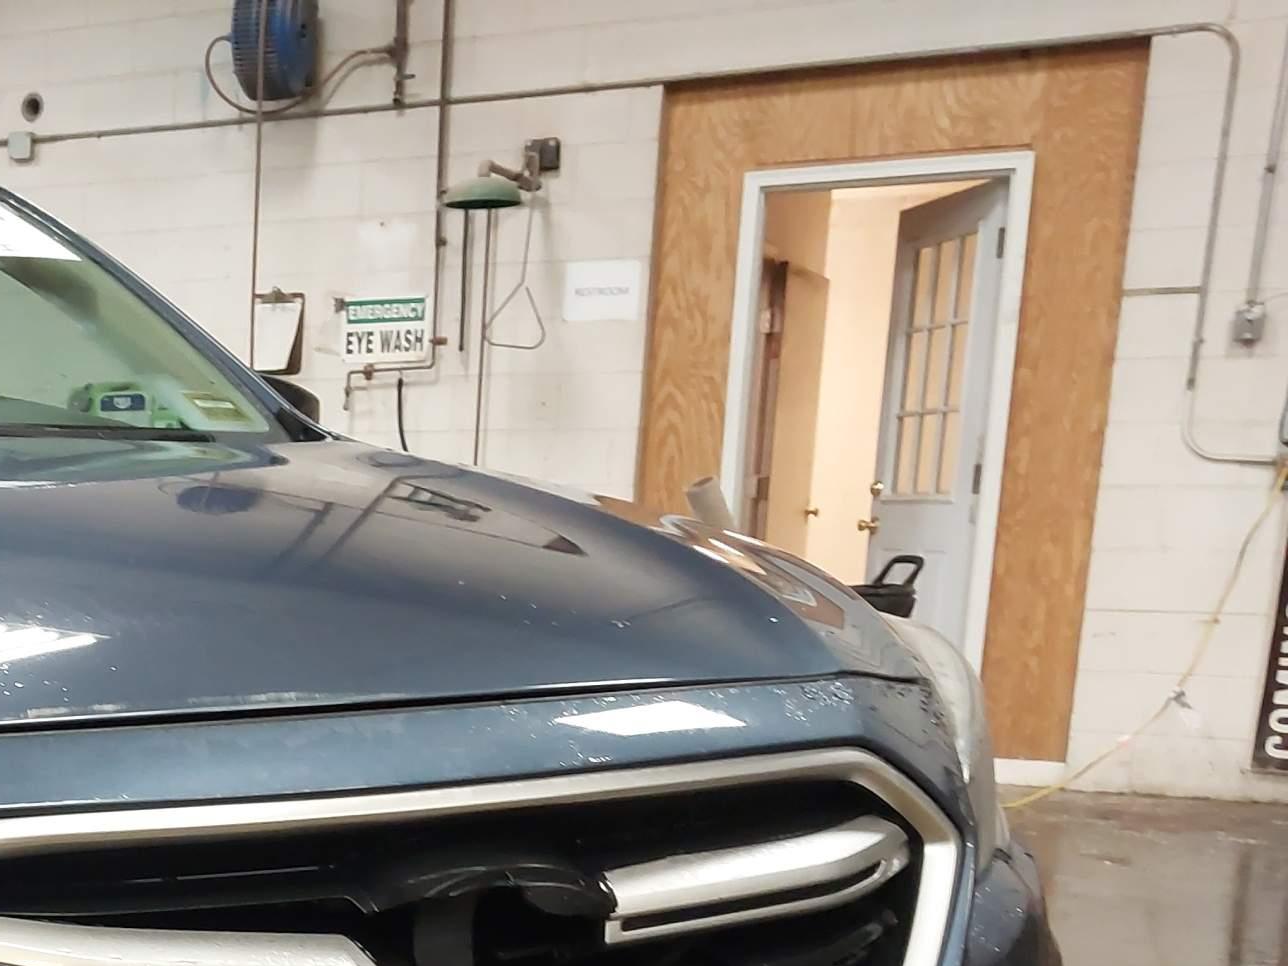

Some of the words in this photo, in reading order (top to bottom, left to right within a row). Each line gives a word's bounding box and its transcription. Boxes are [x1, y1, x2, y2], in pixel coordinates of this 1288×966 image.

[348, 302, 424, 320] EMERGENCY
[346, 331, 374, 355] EYE
[379, 328, 424, 354] WASH
